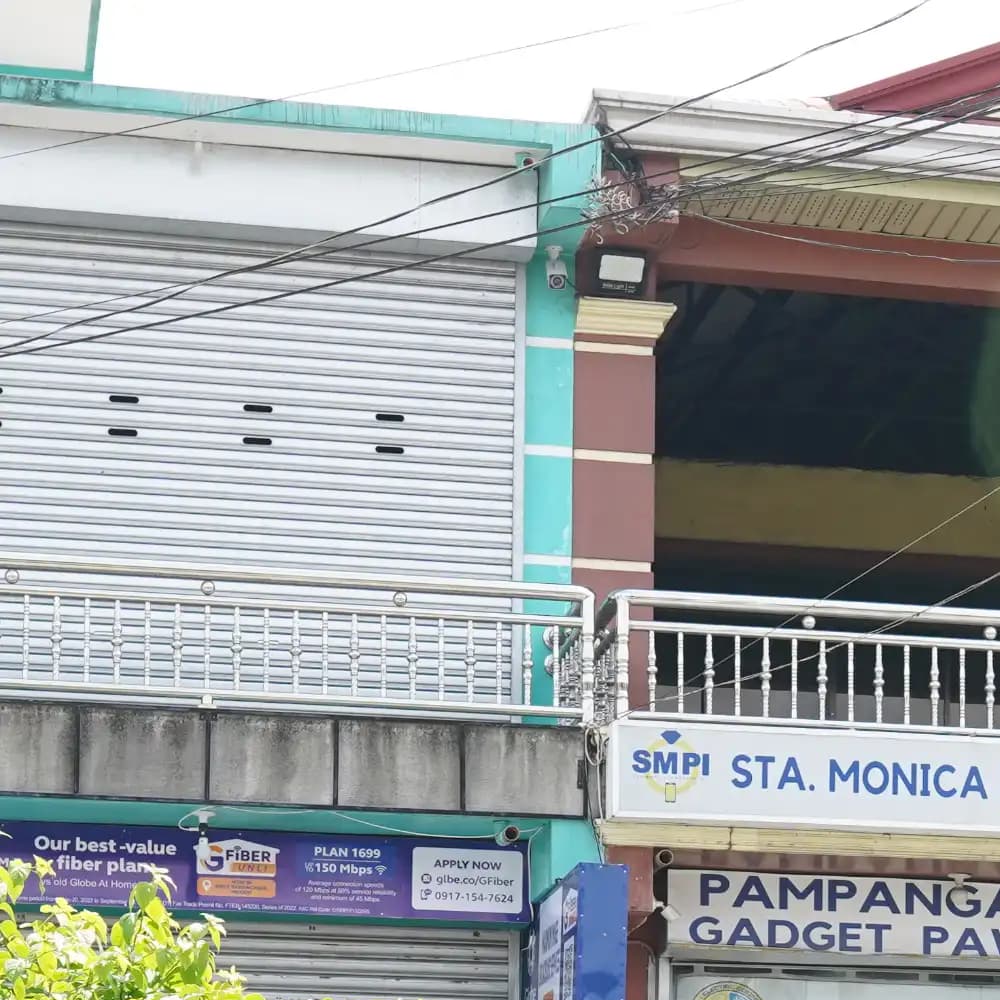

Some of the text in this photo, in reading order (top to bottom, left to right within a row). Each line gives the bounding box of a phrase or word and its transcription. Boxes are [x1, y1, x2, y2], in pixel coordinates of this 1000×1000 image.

[632, 749, 710, 776] SMPI
[731, 754, 815, 791] STA.
[829, 759, 988, 799] MONICA
[34, 835, 71, 851] Our
[75, 836, 117, 854] best
[314, 846, 381, 859] PLAN 1699
[57, 855, 102, 871] fiber
[315, 863, 373, 877] 150 Mbps
[434, 859, 502, 871] APPLY NOW
[54, 877, 67, 886] old
[70, 879, 97, 888] Globe
[99, 880, 109, 888] At
[436, 874, 514, 888] glbe.co/GFiber
[435, 891, 514, 903] 0917-154-7624
[689, 915, 892, 953] GADGET
